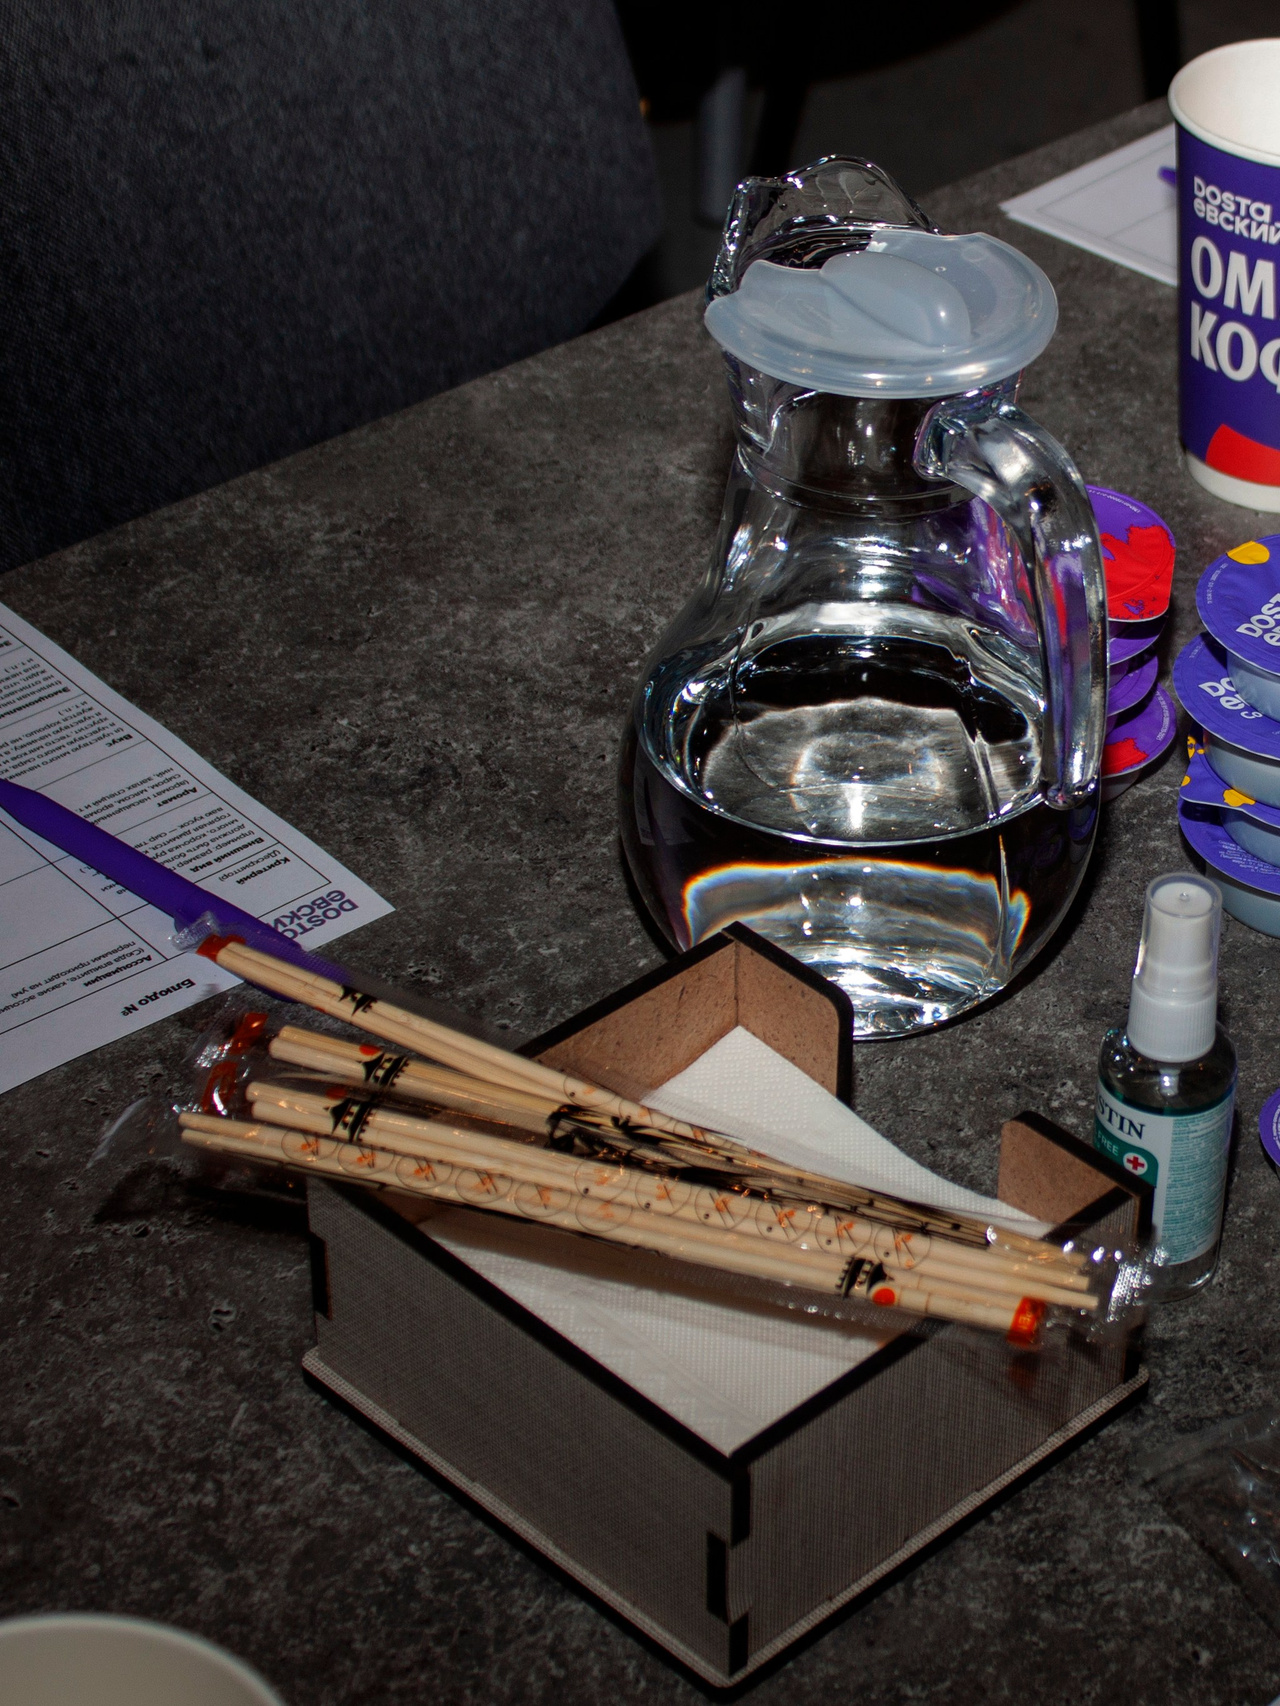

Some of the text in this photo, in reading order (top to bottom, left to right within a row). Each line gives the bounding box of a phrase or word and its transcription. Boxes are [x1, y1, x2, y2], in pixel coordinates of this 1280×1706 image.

[106, 734, 133, 747] Вкус
[37, 745, 66, 758] много
[42, 751, 70, 765] много
[157, 787, 197, 807] Аромат
[178, 816, 204, 829] кусок
[210, 824, 245, 842] должна
[168, 833, 207, 852] корочка
[186, 842, 209, 852] быть
[213, 837, 264, 863] Внешний
[177, 849, 212, 867] размер
[190, 861, 213, 872] вид
[236, 857, 290, 884] Критерий
[91, 941, 135, 962] первыми
[114, 948, 144, 962] (Сюда
[44, 961, 90, 984] приходят
[84, 955, 152, 986] Ассоциации
[37, 982, 67, 996] какие
[138, 979, 195, 1005] Блюдо
[1097, 1131, 1120, 1156] FREE
